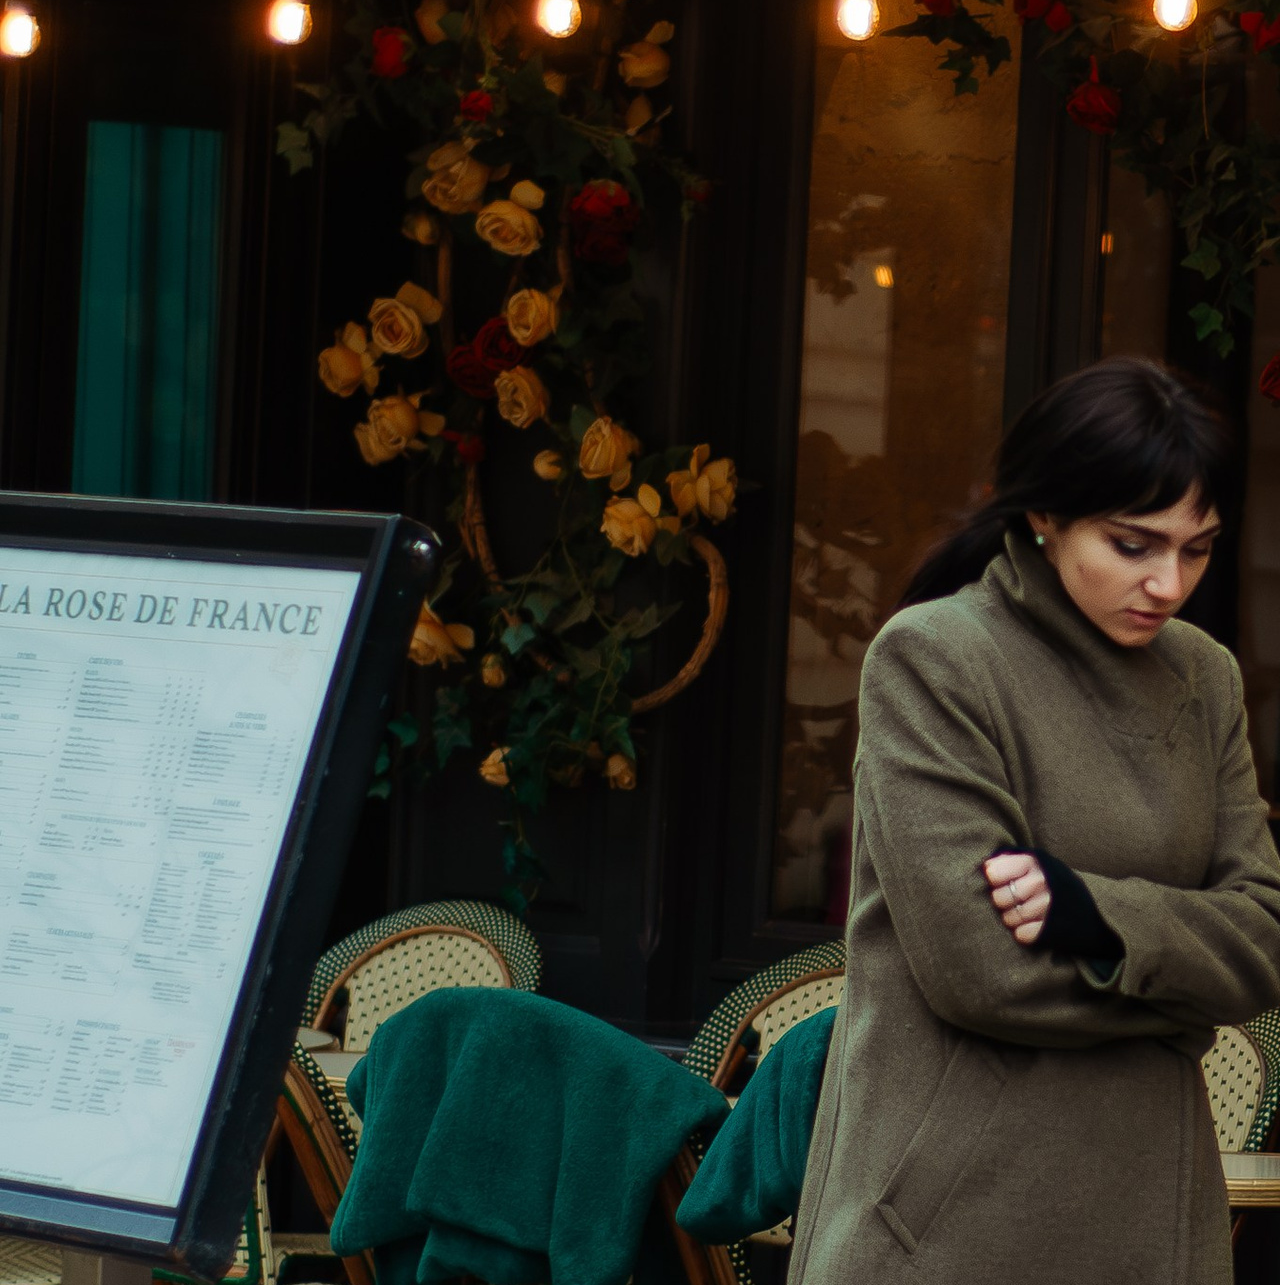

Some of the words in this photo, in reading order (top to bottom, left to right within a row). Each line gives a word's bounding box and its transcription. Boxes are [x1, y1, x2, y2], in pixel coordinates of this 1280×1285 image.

[0, 584, 31, 615] LA
[43, 587, 128, 622] ROSE
[133, 594, 179, 626] DE
[186, 597, 323, 637] FRANCE
